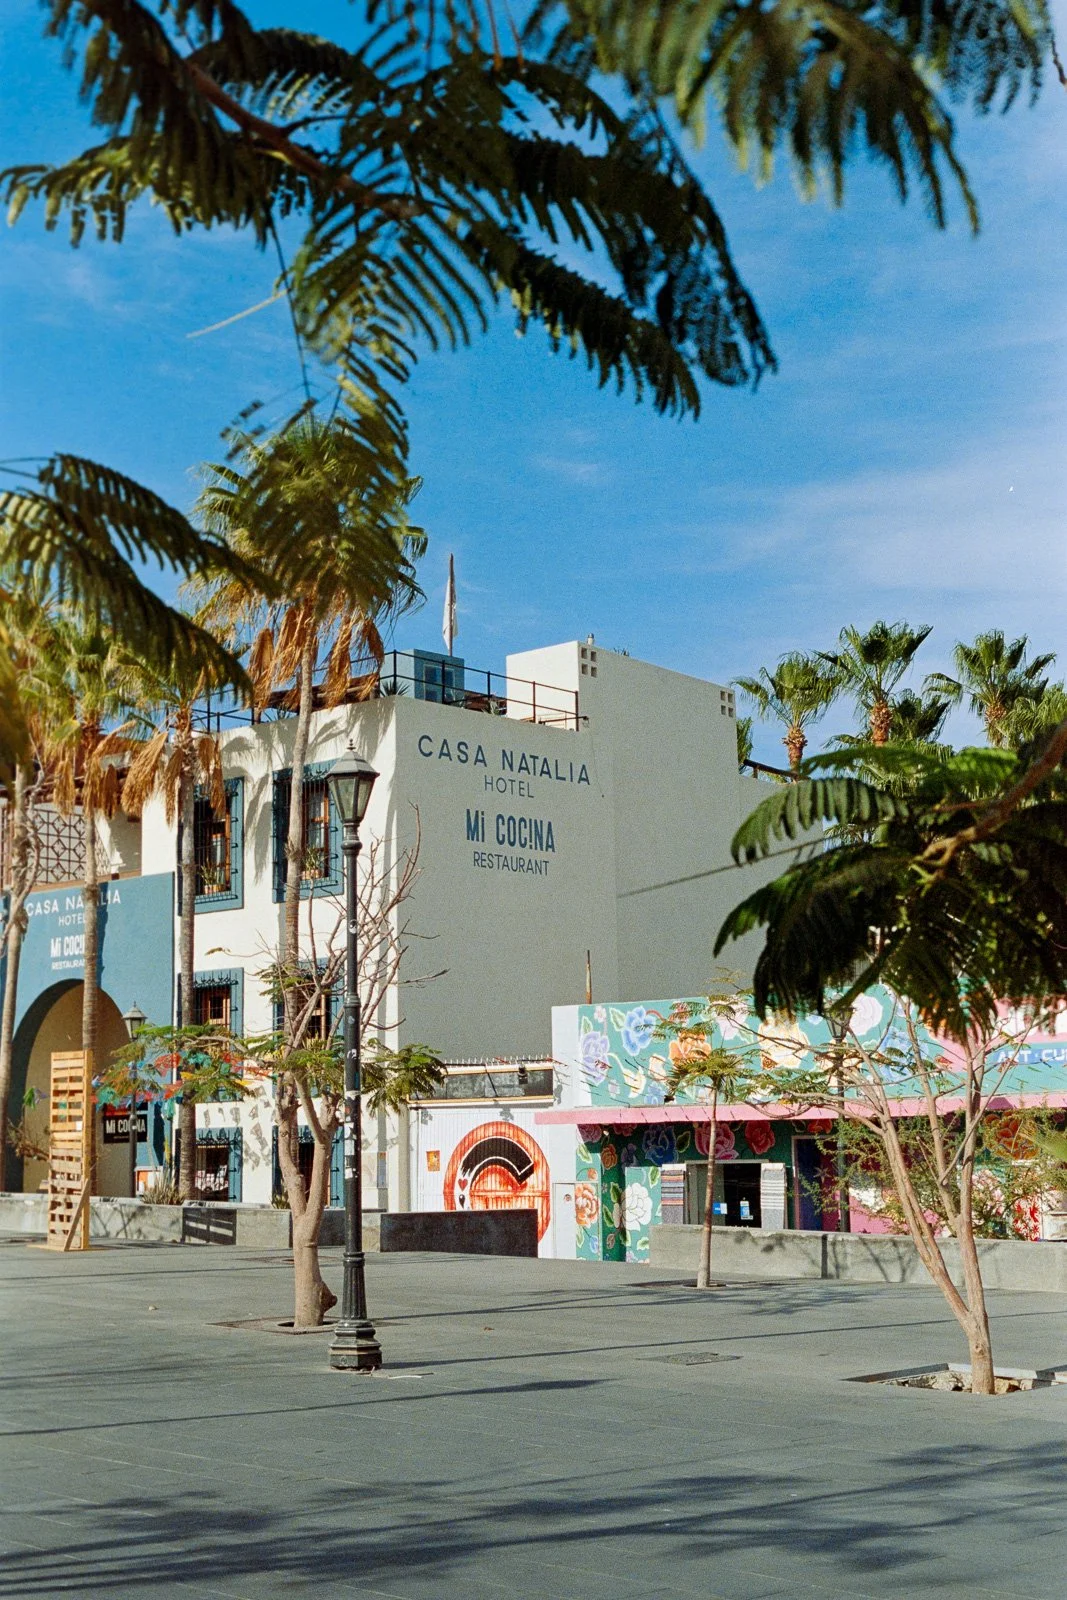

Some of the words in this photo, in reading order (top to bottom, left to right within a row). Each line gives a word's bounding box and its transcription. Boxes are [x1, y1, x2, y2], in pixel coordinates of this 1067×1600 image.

[418, 734, 487, 768] CASA
[502, 749, 590, 785] NATALIA
[484, 774, 534, 798] HOTEL
[473, 851, 549, 876] RESTAURANT
[25, 898, 59, 917] CASA
[65, 889, 121, 911] NALIA
[1041, 1048, 1067, 1062] CU
